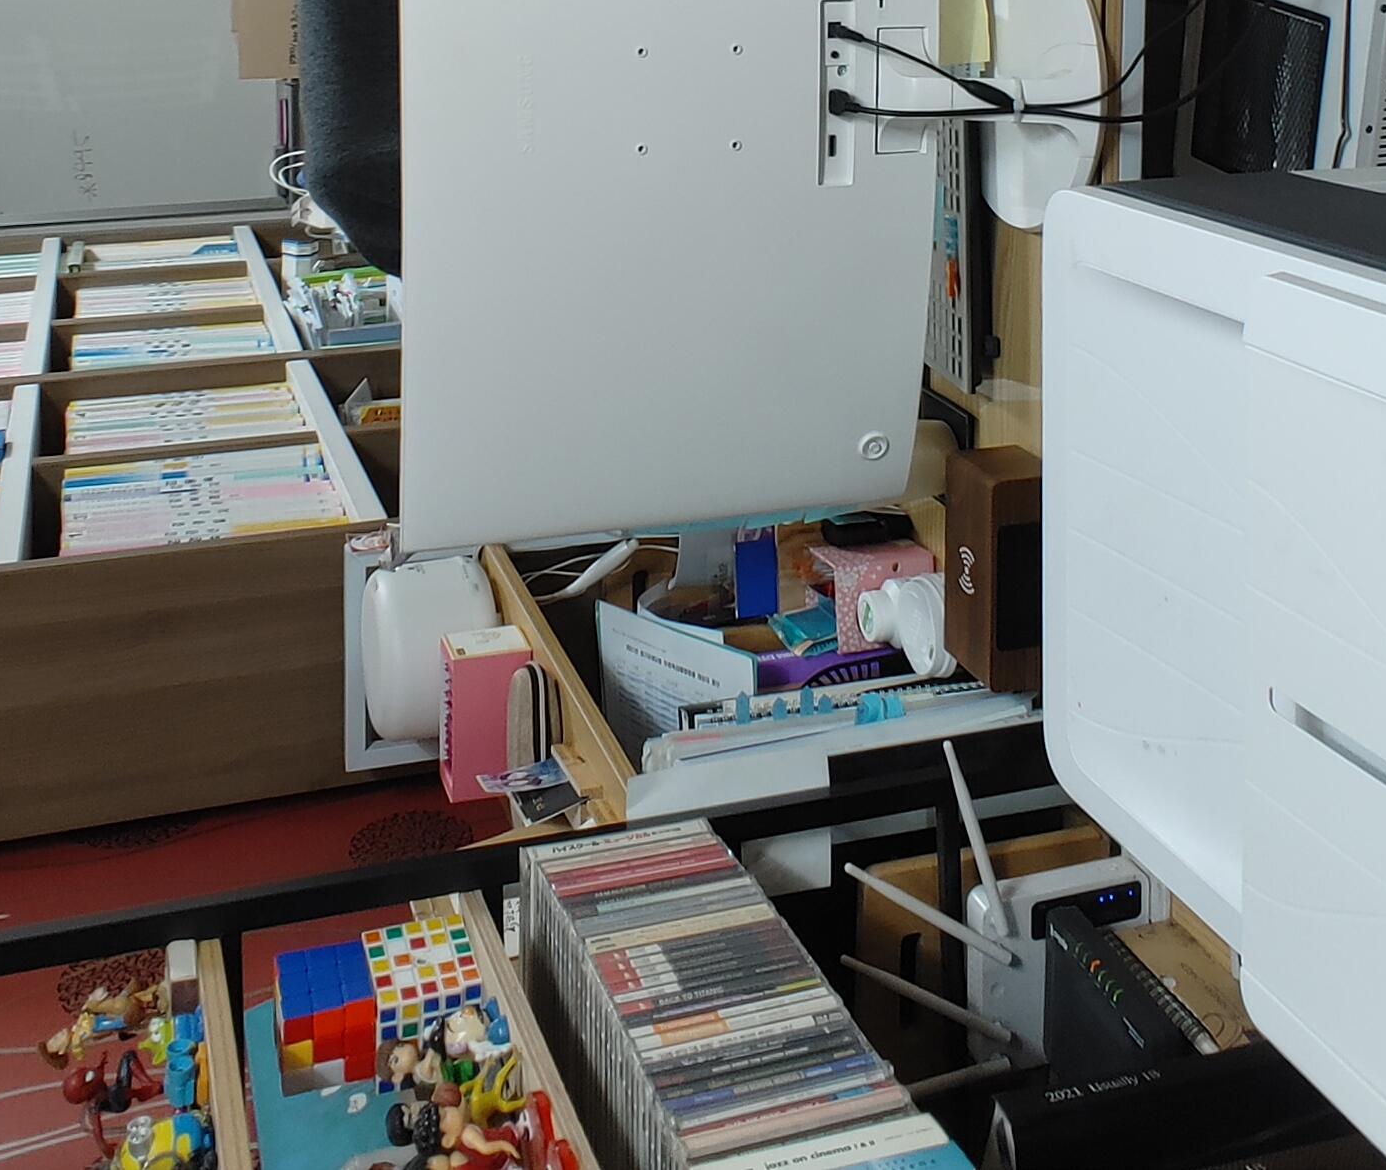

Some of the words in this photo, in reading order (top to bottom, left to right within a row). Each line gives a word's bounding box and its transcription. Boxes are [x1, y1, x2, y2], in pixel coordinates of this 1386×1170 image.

[1045, 1086, 1084, 1103] 2021
[1088, 1074, 1139, 1094] Usually
[793, 1156, 807, 1164] on
[811, 1144, 852, 1162] cinema
